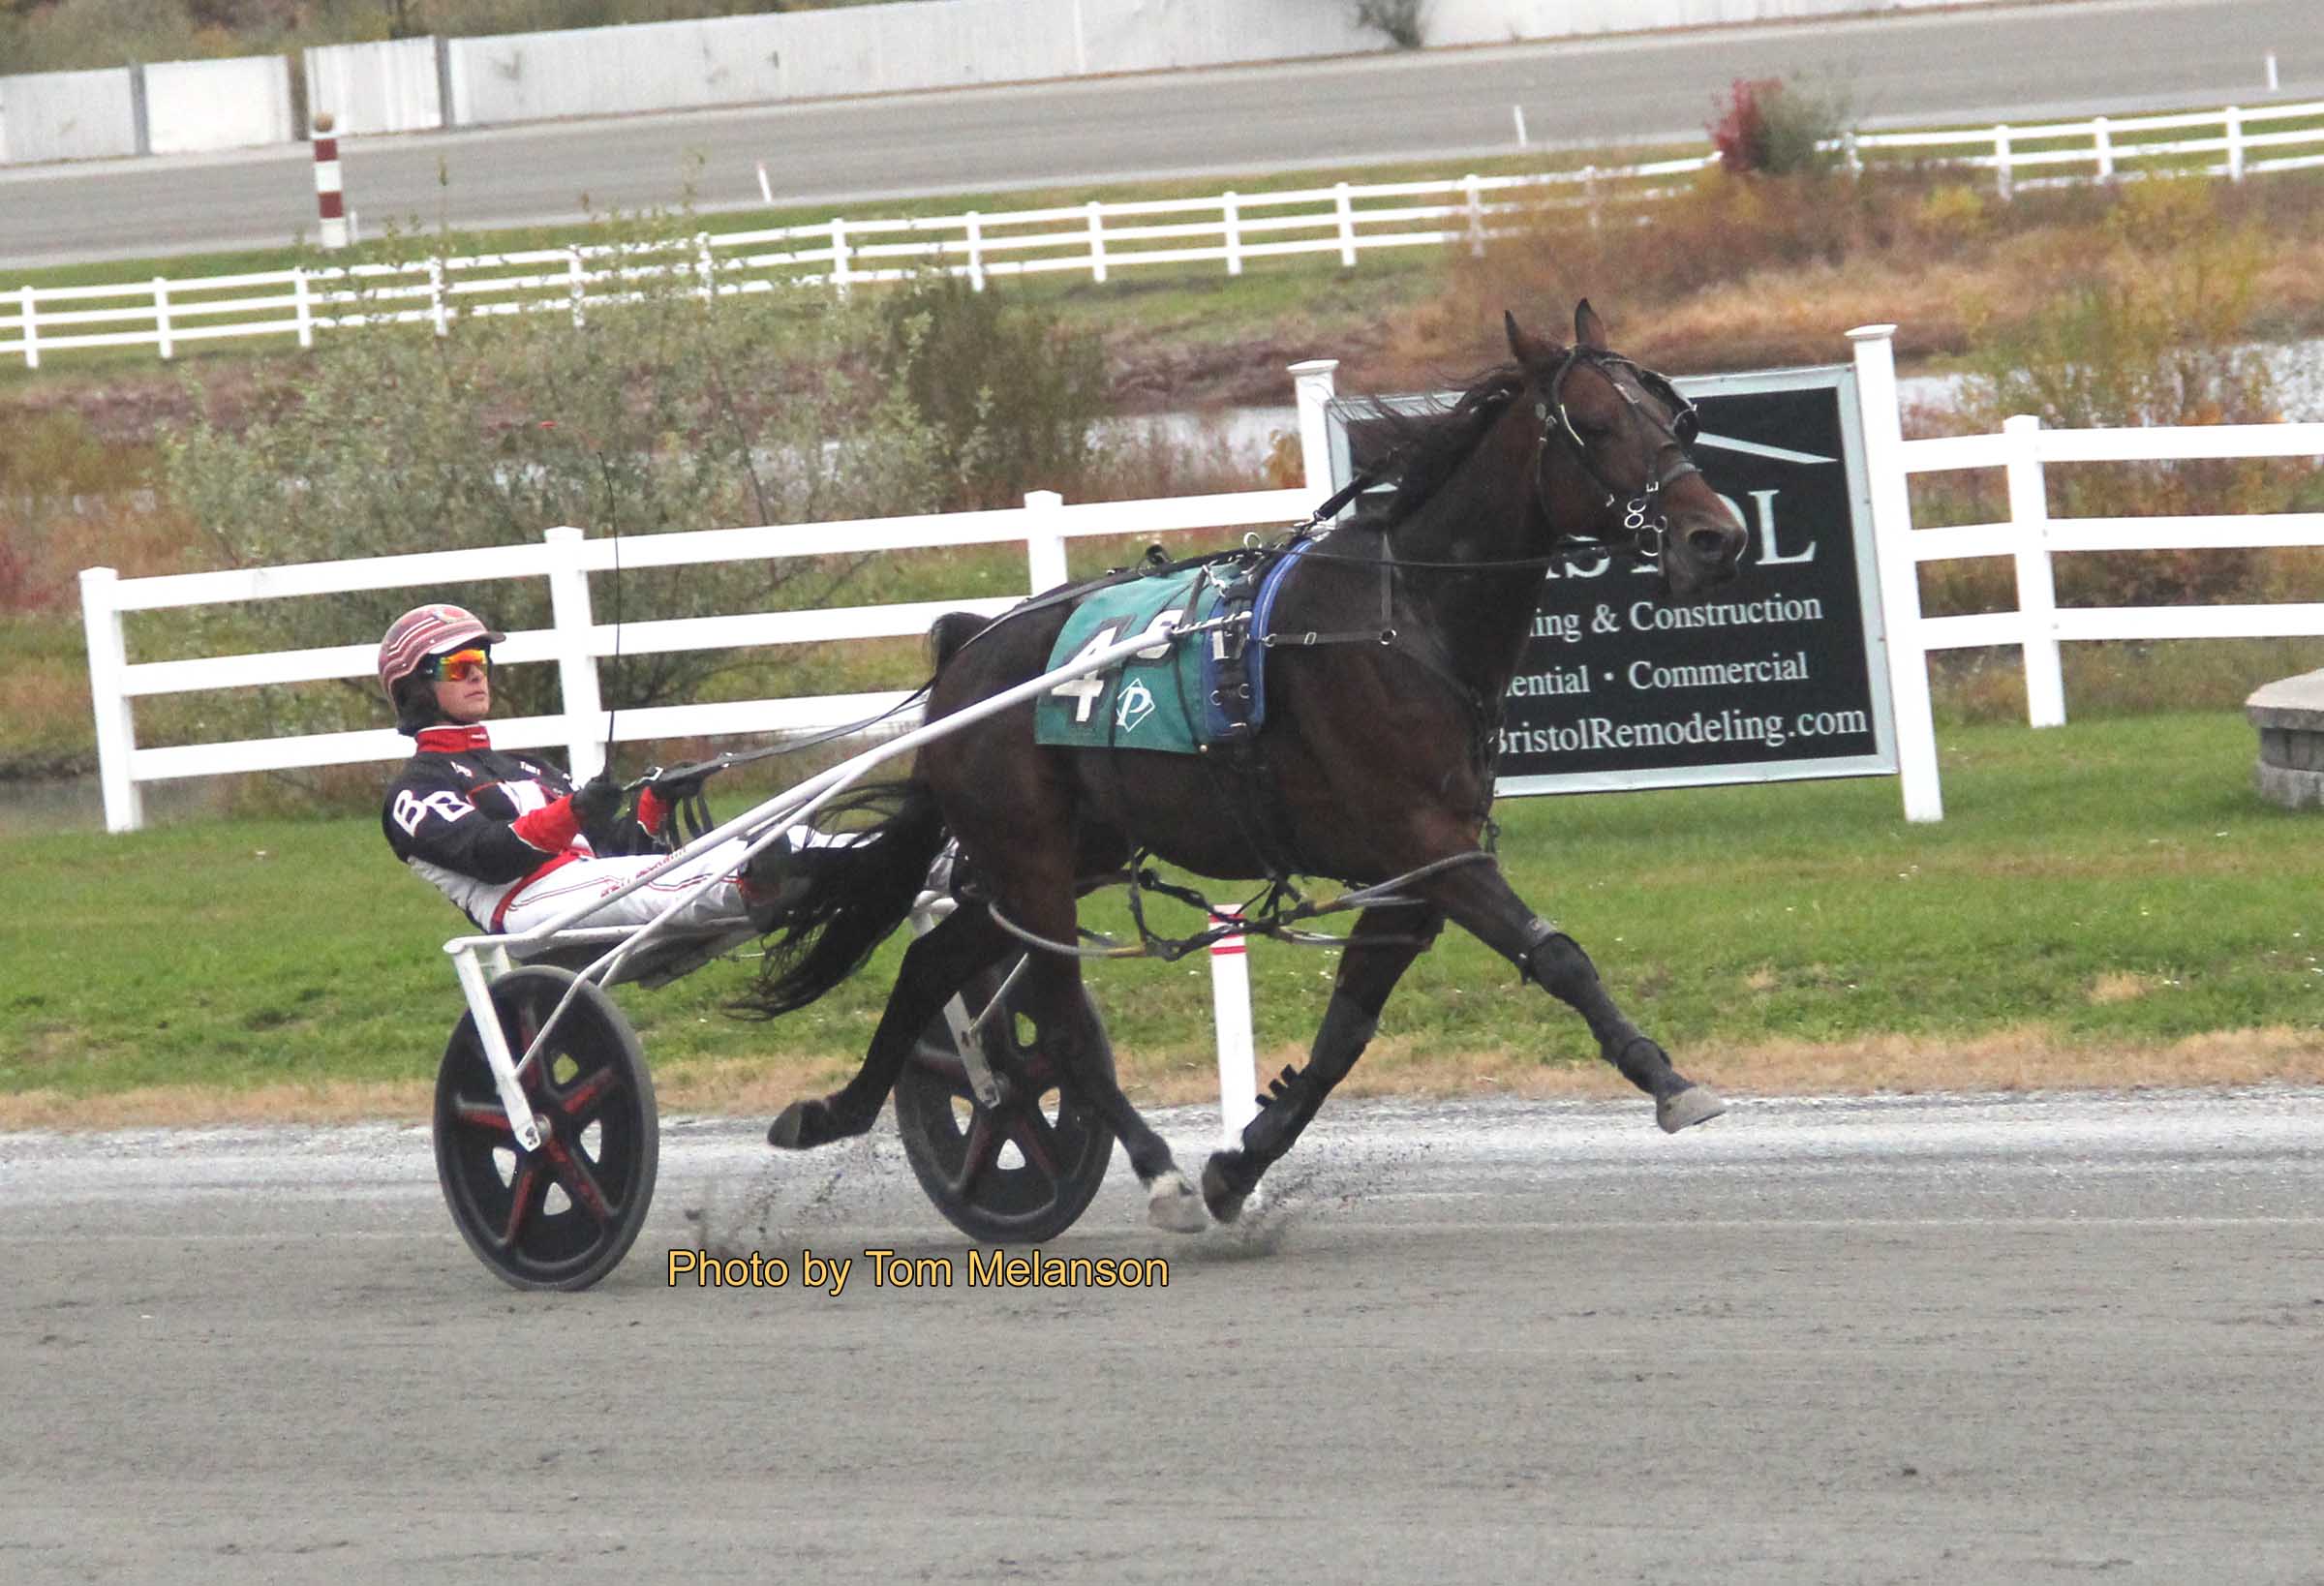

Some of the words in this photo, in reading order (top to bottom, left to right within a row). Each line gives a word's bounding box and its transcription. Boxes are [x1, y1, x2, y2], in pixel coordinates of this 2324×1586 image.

[1529, 607, 1582, 642] ing
[1592, 604, 1620, 634] &
[1629, 593, 1823, 631] Construction
[1052, 626, 1117, 721] 4
[1506, 664, 1590, 697] ential
[1628, 652, 1809, 690] Commercial
